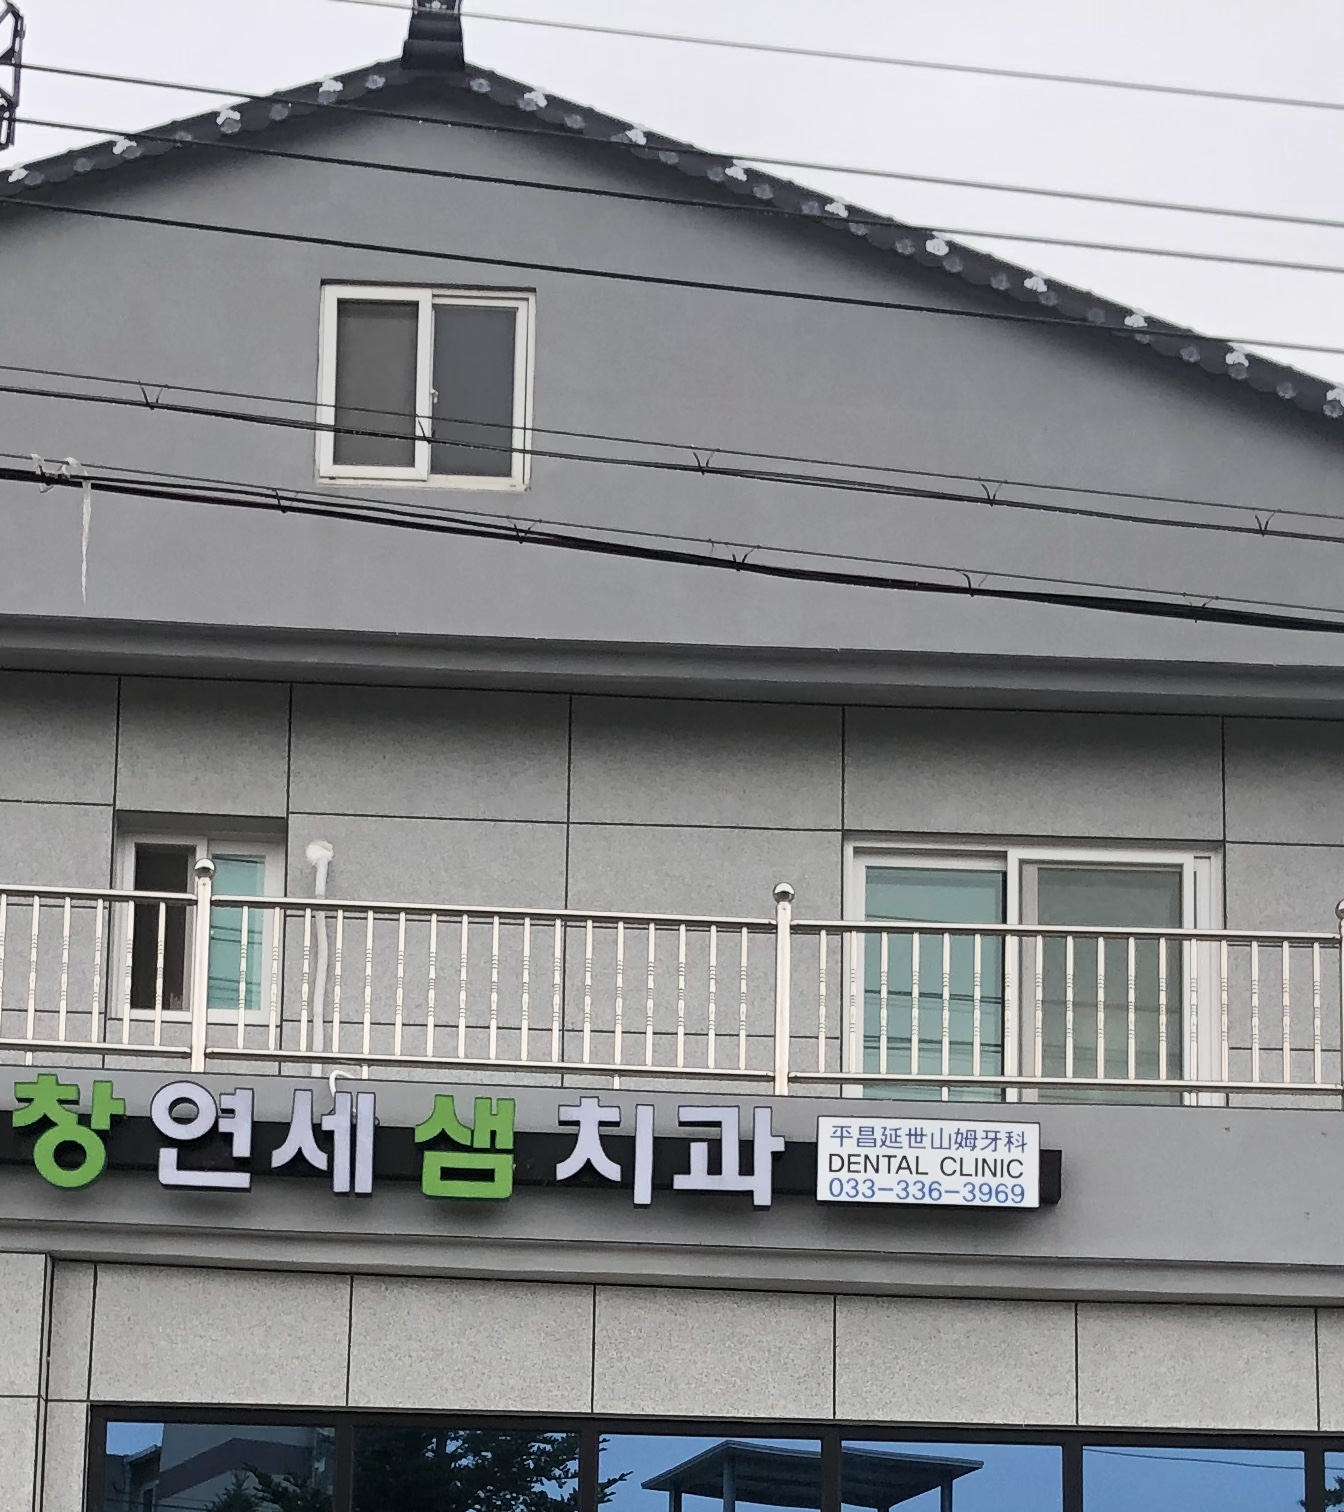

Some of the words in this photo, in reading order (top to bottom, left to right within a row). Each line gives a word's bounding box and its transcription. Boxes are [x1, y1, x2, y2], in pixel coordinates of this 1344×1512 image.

[556, 1096, 786, 1208] 치과
[829, 1124, 1028, 1154] 平昌延世山姆牙科
[828, 1153, 929, 1176] DENTAL
[939, 1156, 1025, 1179] CLINIC
[828, 1177, 1026, 1204] 033-336-3969
